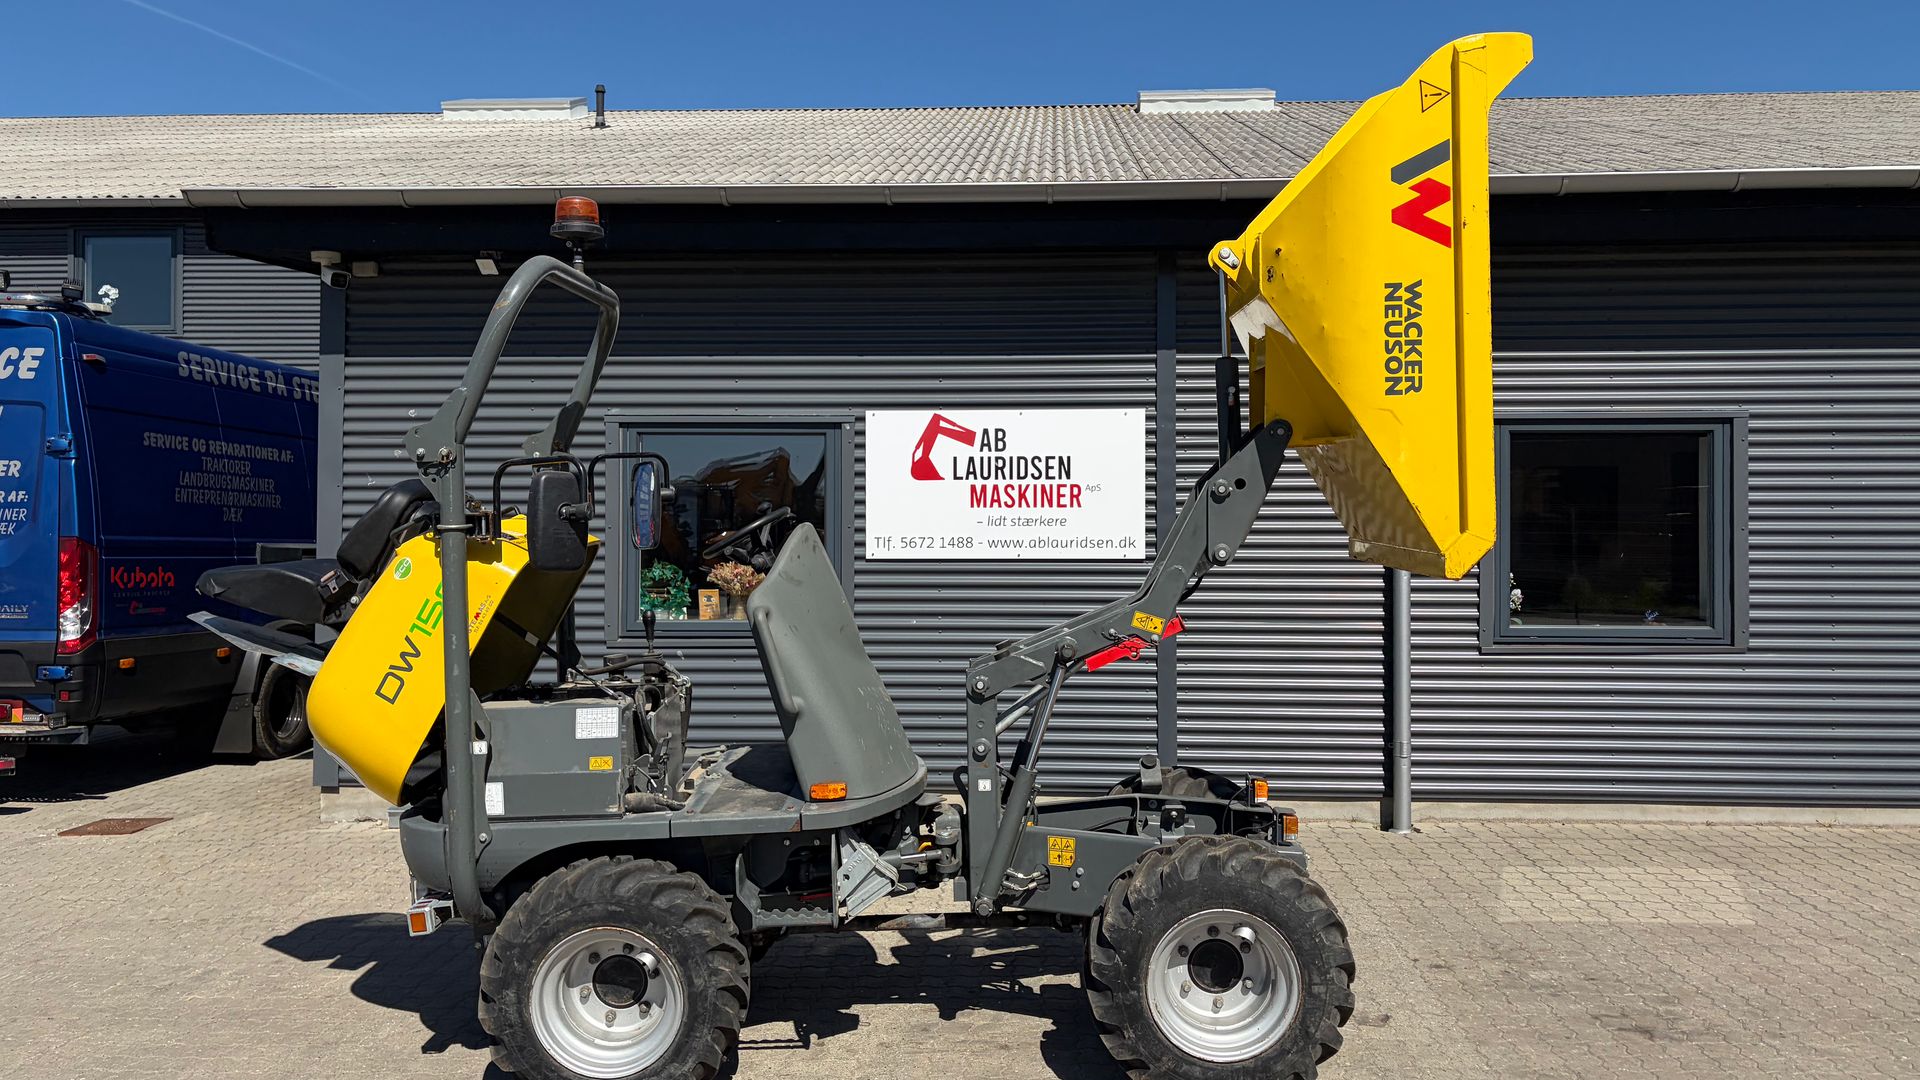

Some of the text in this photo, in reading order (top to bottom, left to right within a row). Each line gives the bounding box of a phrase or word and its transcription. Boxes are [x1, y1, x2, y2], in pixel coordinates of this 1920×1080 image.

[1384, 282, 1403, 396] NEUSON
[1404, 279, 1423, 396] WACKER
[177, 351, 261, 393] SERVICE
[264, 368, 288, 397] PÅ
[143, 432, 294, 463] SERVICE OG REPARATIONER AF:
[979, 428, 1007, 452] AB
[201, 456, 251, 475] TRAKTORER
[953, 456, 1071, 480] LAURIDSEN
[179, 471, 275, 493] LANDBRUGSMASKINER
[7, 490, 28, 503] AF:
[970, 484, 1102, 508] MASKINER ApS
[222, 507, 243, 522] DÆK
[987, 515, 1008, 527] lidt
[1010, 515, 1068, 527] stærkere
[874, 536, 896, 551] Tlf.
[900, 536, 935, 549] 5672
[939, 536, 974, 549] 1488
[987, 536, 1137, 549] www.ablauridsen.dk
[110, 565, 175, 589] Kubota
[0, 604, 29, 613] AILY
